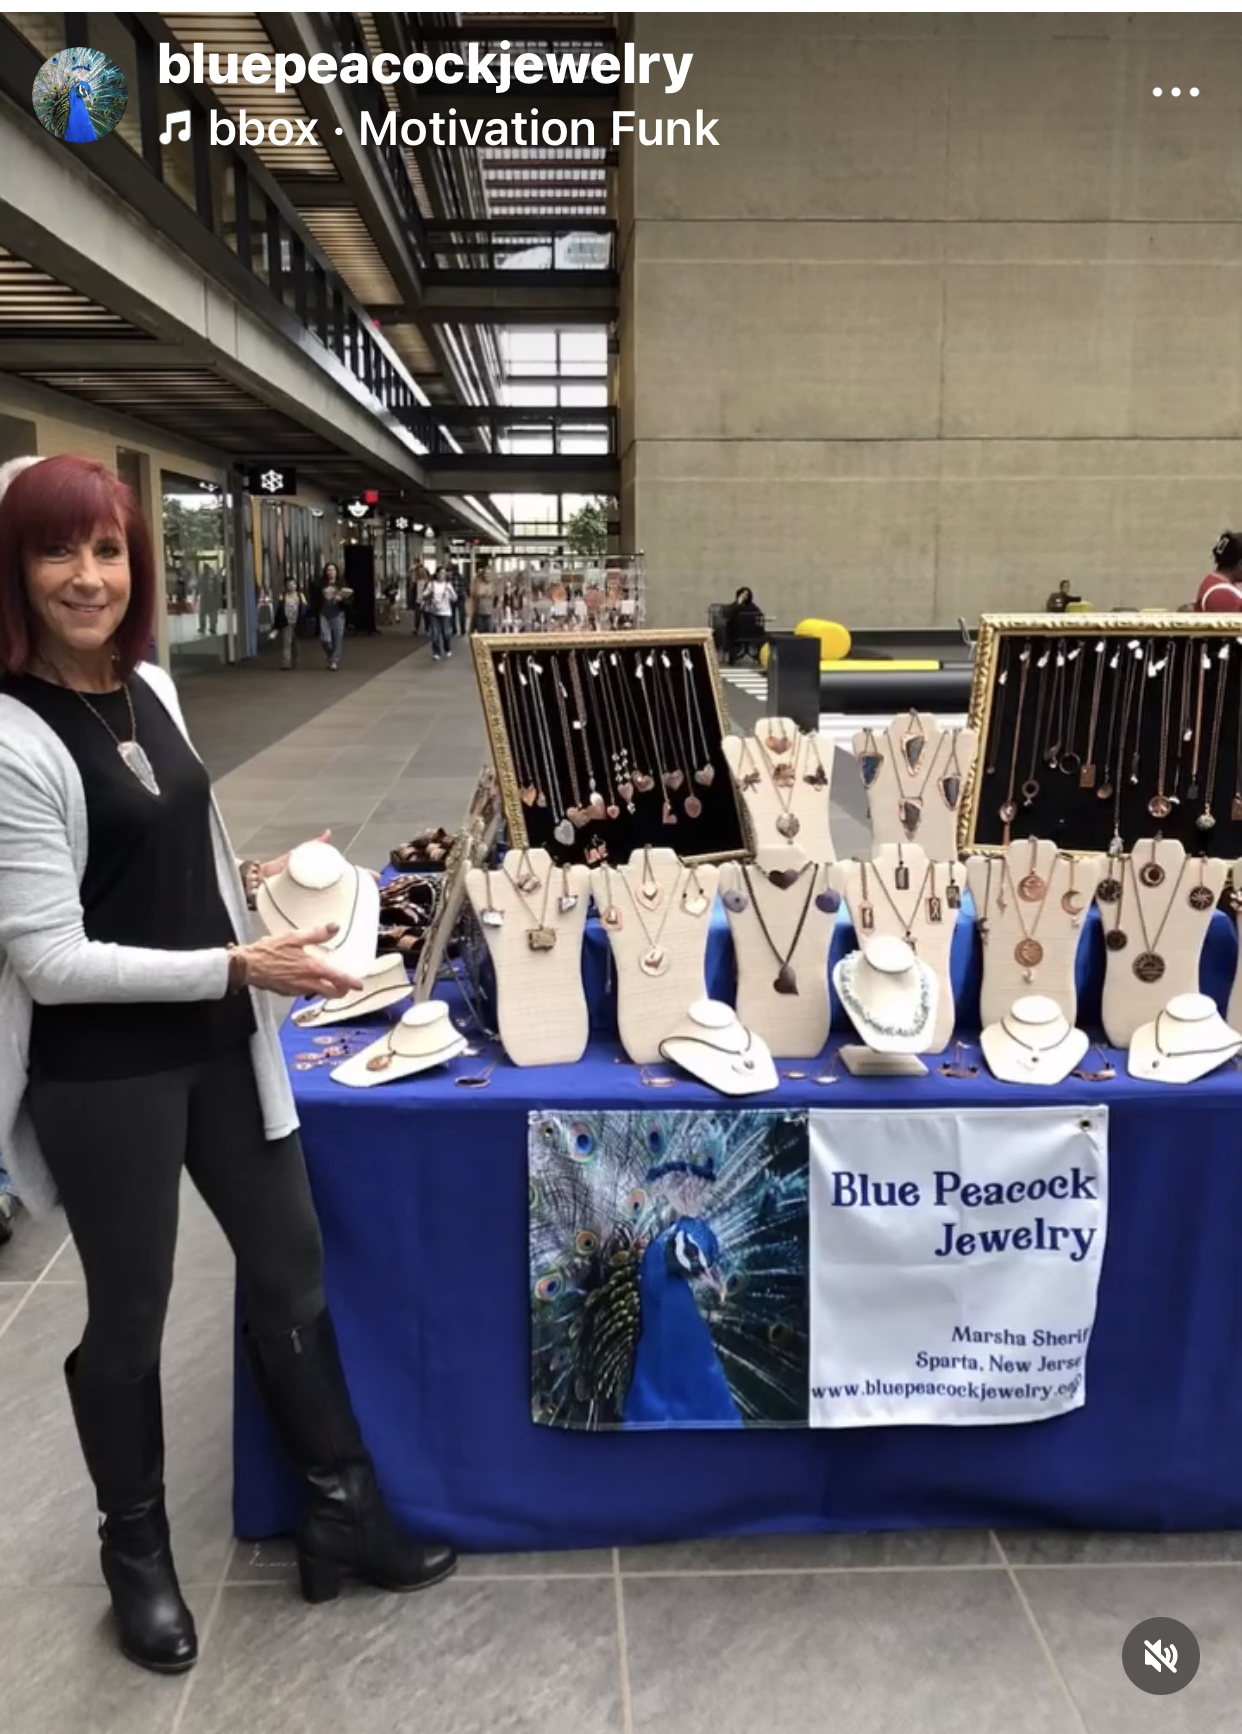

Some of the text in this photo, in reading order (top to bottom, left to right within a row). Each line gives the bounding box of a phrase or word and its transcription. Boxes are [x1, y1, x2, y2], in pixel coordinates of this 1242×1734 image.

[831, 1167, 1097, 1207] Blue Peacock
[935, 1217, 1097, 1262] Jewelry
[951, 1326, 1090, 1347] Marsha Sherif
[915, 1351, 1082, 1372] Sparta, New Jerse
